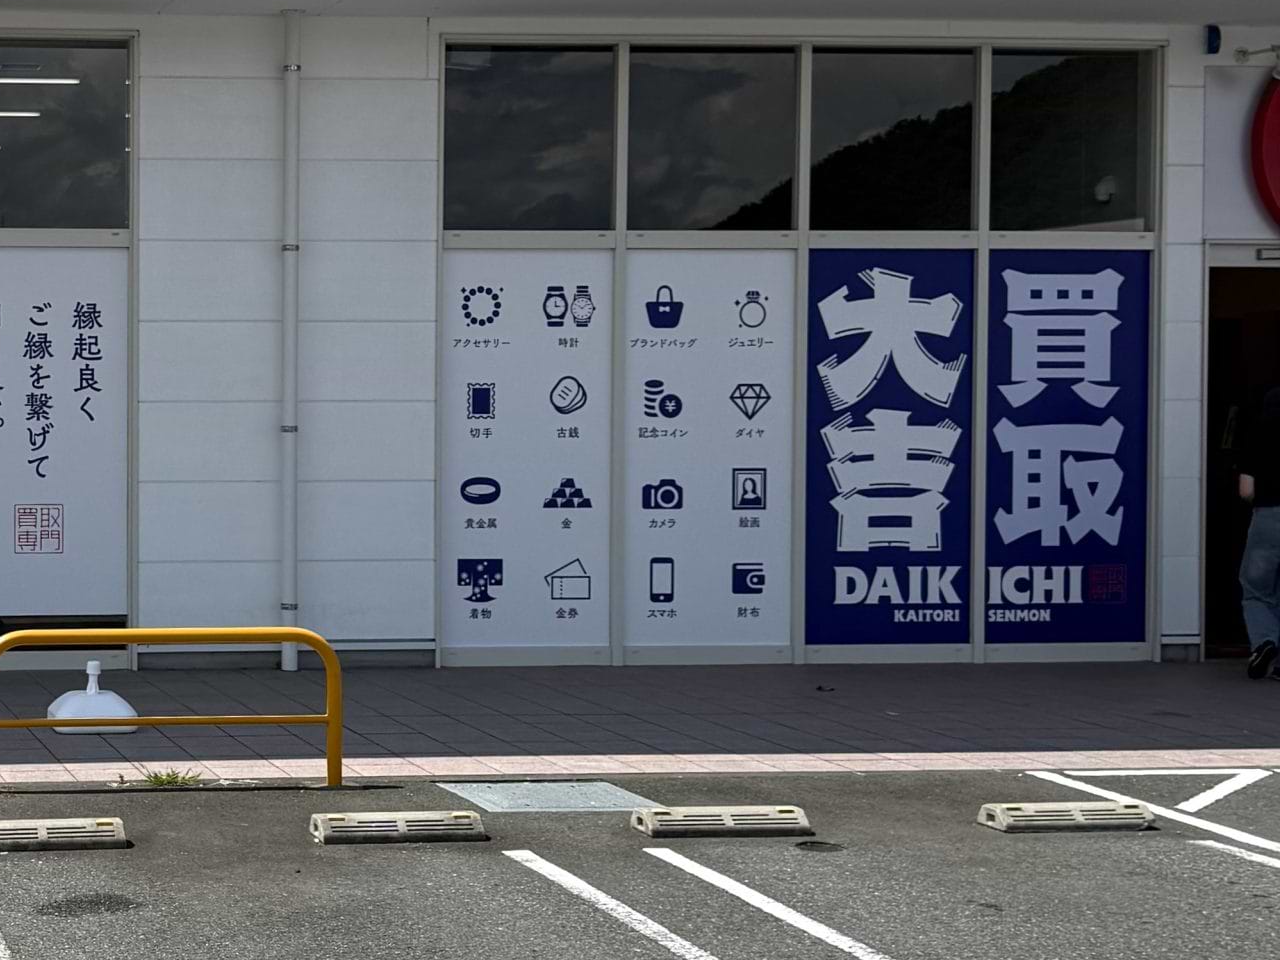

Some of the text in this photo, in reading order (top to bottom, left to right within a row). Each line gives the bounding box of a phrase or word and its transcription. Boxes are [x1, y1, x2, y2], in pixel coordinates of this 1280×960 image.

[453, 338, 511, 349] アクセサリー
[558, 337, 580, 348] 時計
[630, 337, 698, 349] ブランドバッグ
[728, 337, 774, 349] ジュエリー
[71, 301, 103, 422] 縁起良く
[22, 302, 55, 479] ご縁を繋げて
[816, 267, 967, 551] 大吉
[993, 268, 1125, 546] 買取
[469, 427, 493, 439] 切手
[556, 426, 580, 439] 古銭
[638, 426, 689, 439] 記念コイン
[735, 427, 765, 439] ダイヤ
[464, 517, 497, 530] 貴金属
[561, 517, 573, 529] 金
[648, 518, 677, 529] カメラ
[738, 516, 761, 528] 絵画
[469, 608, 492, 620] 着物
[555, 607, 579, 619] 金券
[647, 608, 677, 619] スマホ
[737, 606, 761, 618] 財布
[893, 608, 1052, 623] KAITORI SENMON
